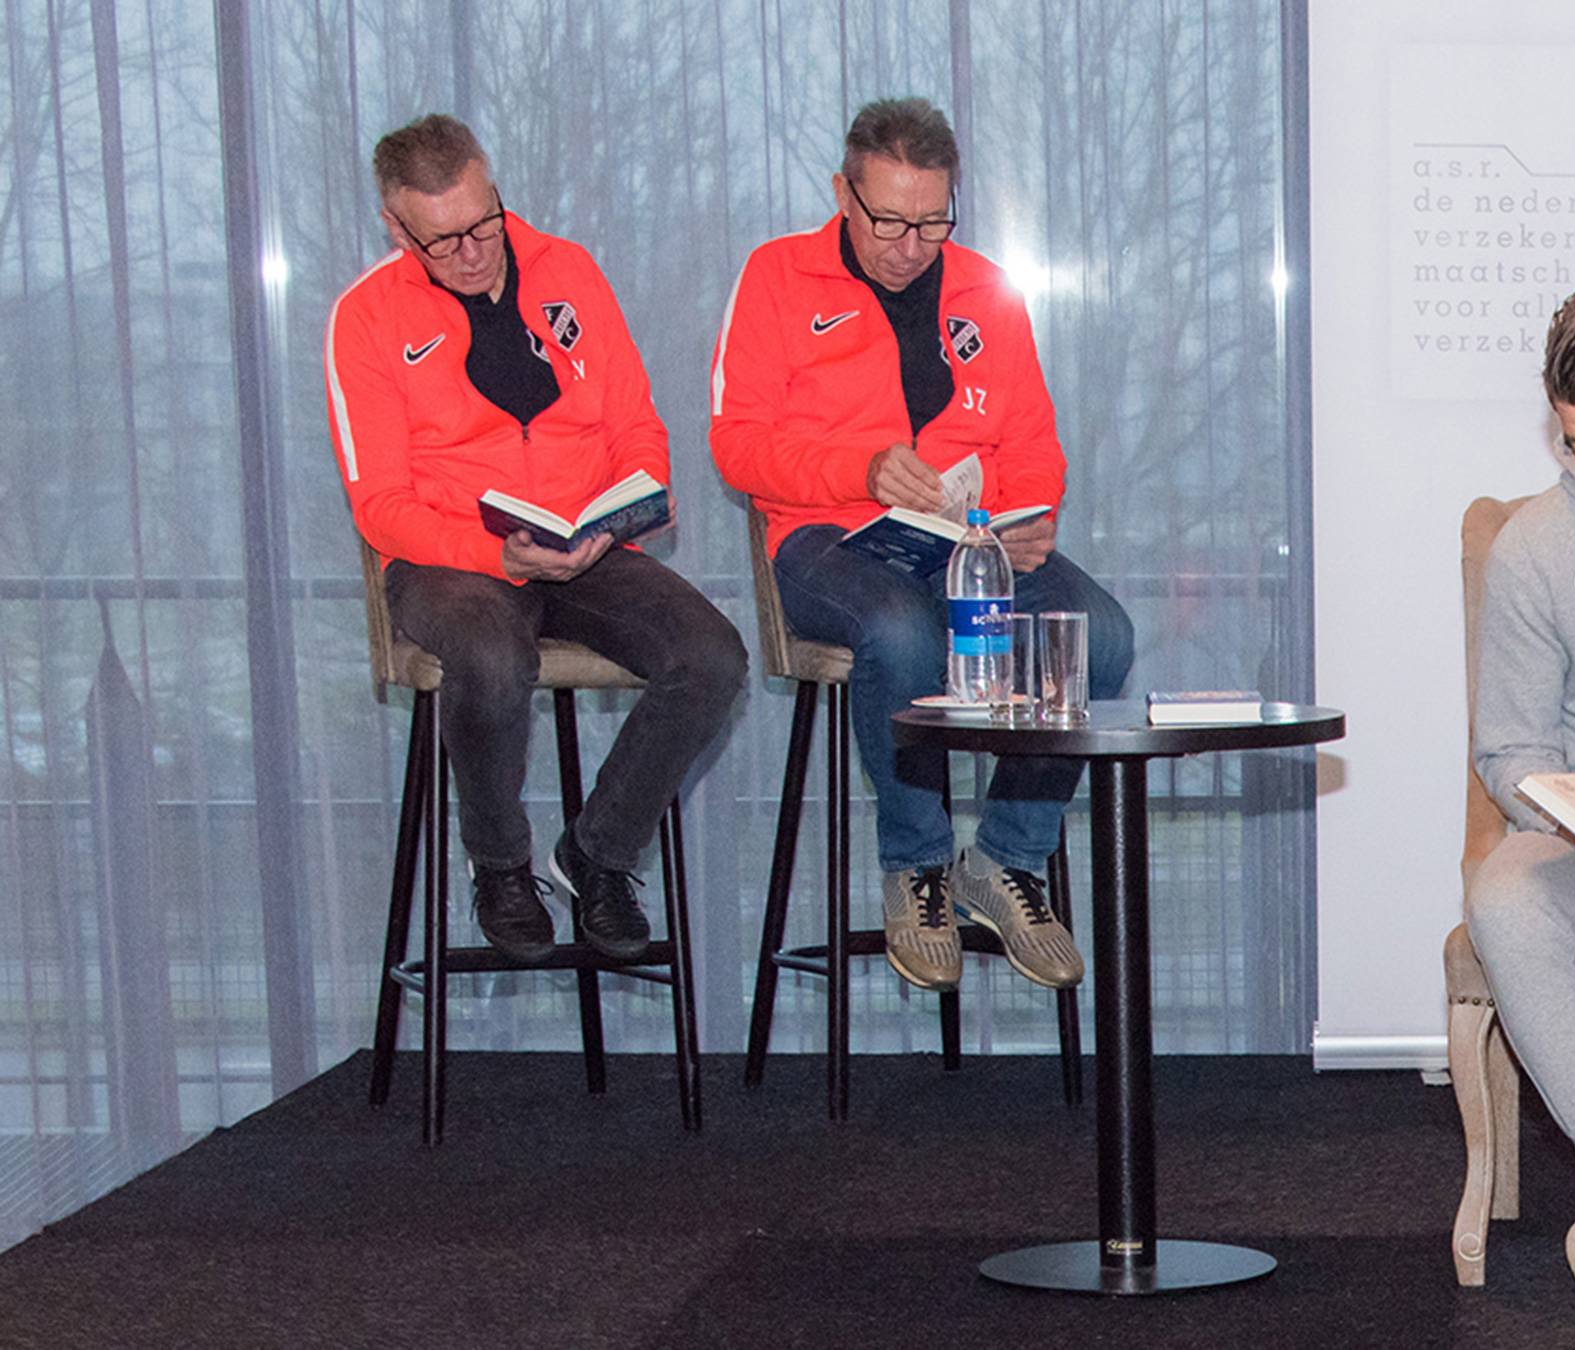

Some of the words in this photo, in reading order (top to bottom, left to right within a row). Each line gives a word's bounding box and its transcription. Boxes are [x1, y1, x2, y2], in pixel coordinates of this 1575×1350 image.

[1413, 158, 1501, 178] a.s.r.
[1413, 187, 1453, 213] de
[1414, 298, 1493, 317] voor
[962, 387, 987, 415] JZ
